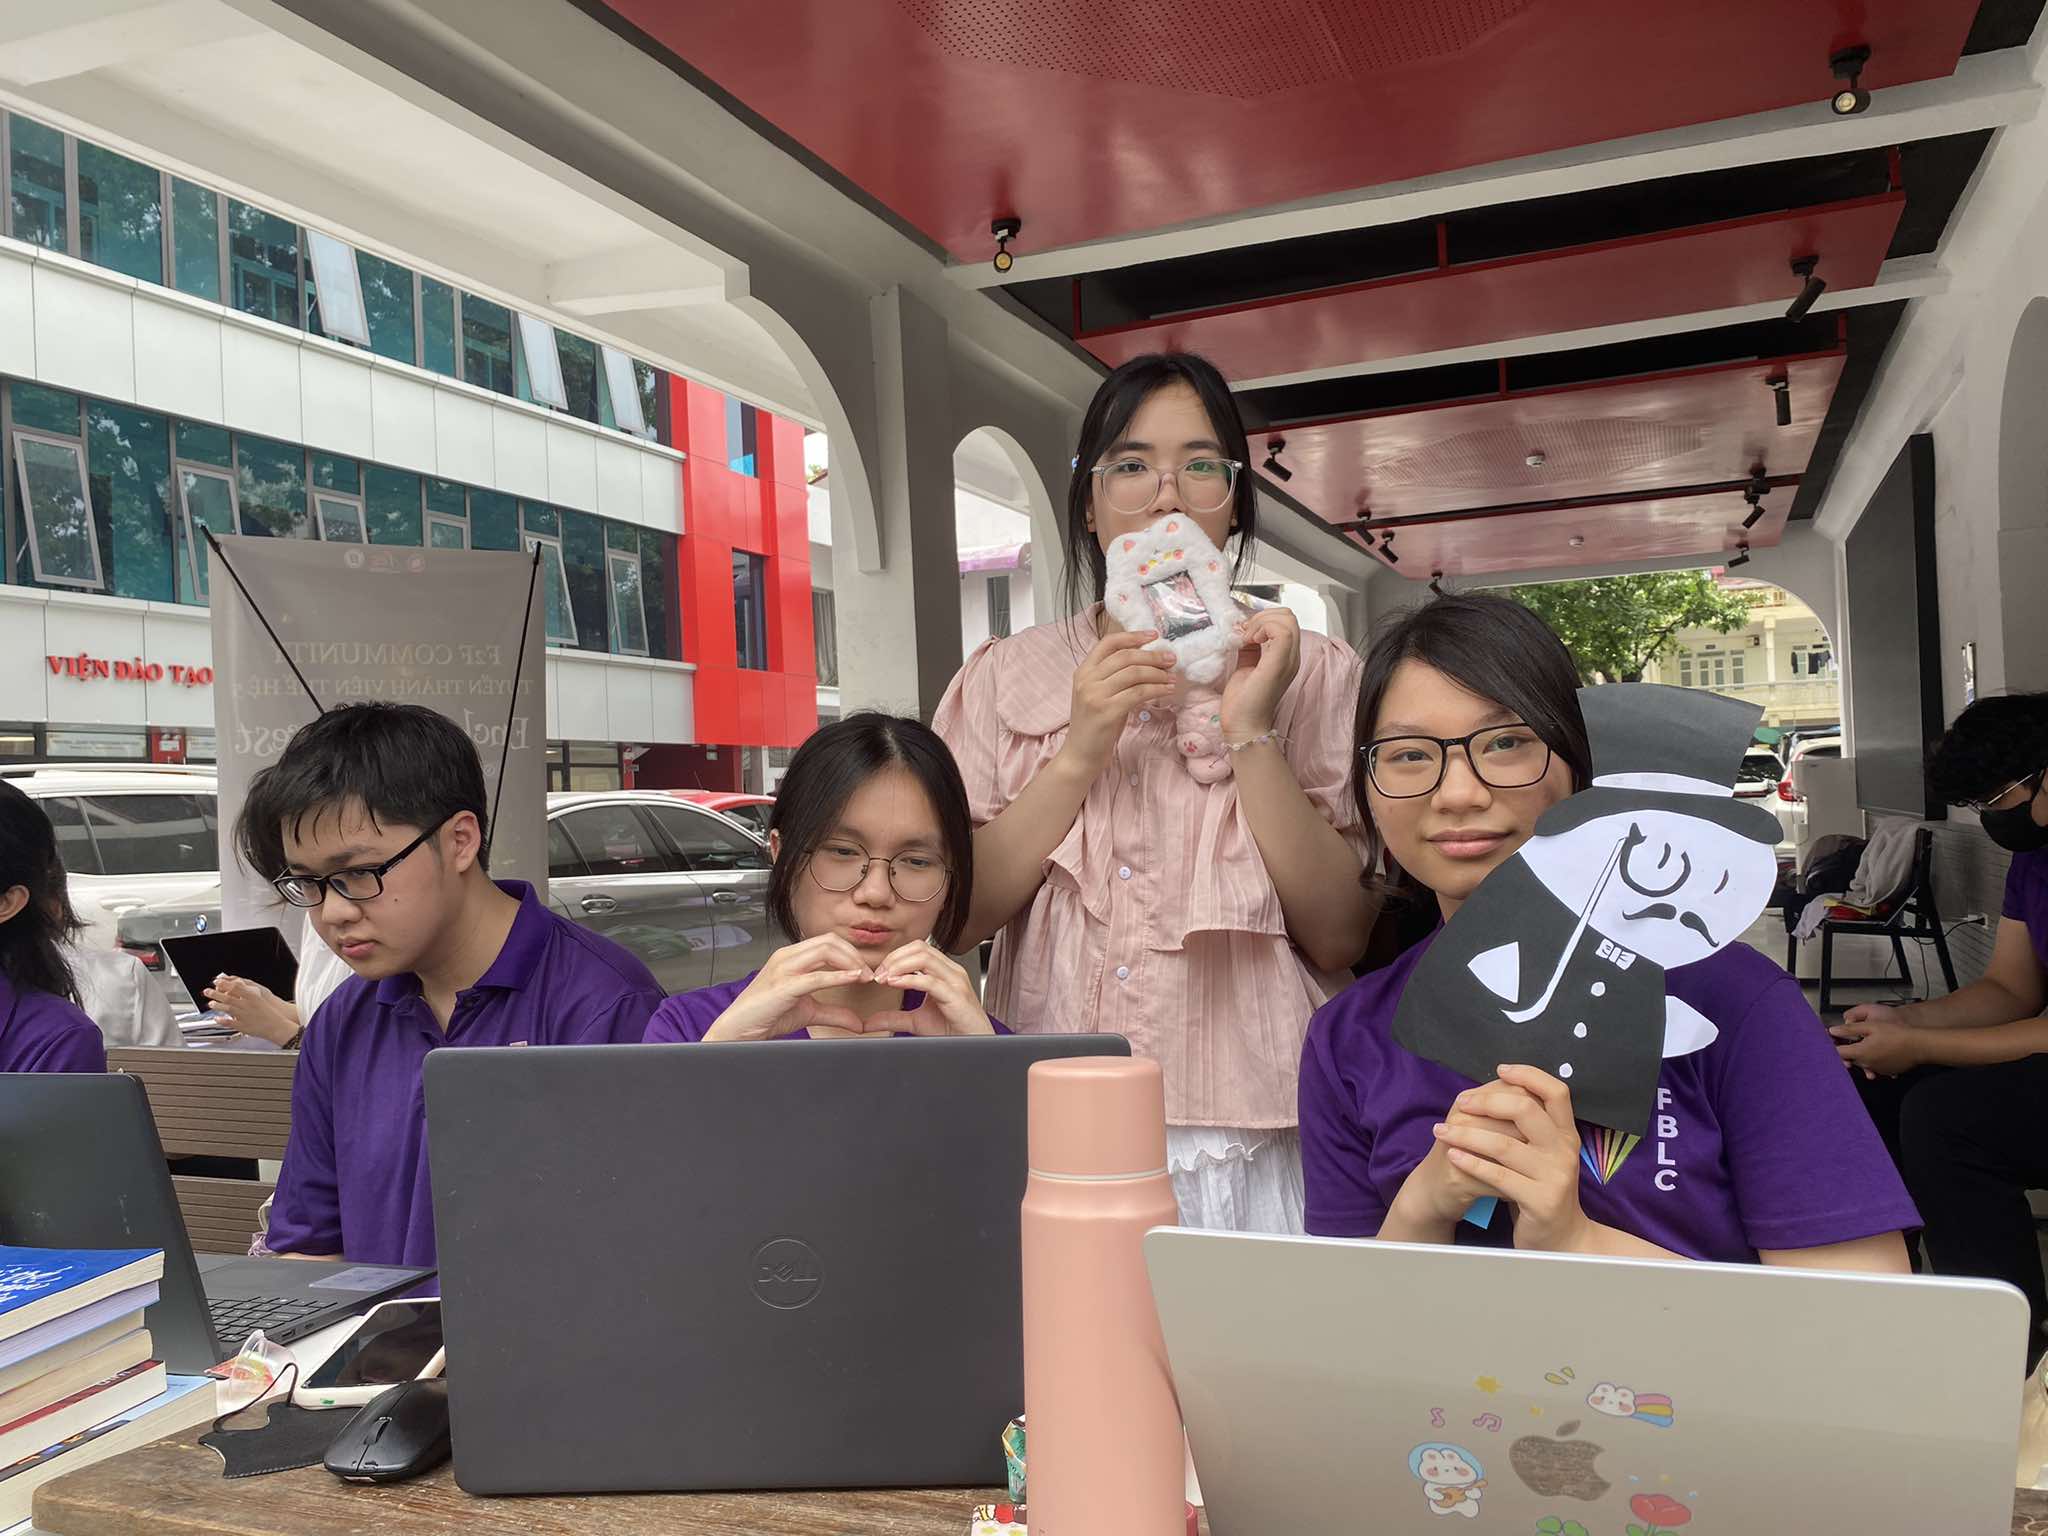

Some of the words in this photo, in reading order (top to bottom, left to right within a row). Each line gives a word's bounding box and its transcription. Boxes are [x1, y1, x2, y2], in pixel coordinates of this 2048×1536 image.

[46, 653, 110, 682] VIỆN
[114, 656, 164, 681] ĐÀO
[168, 664, 214, 688] TẠO
